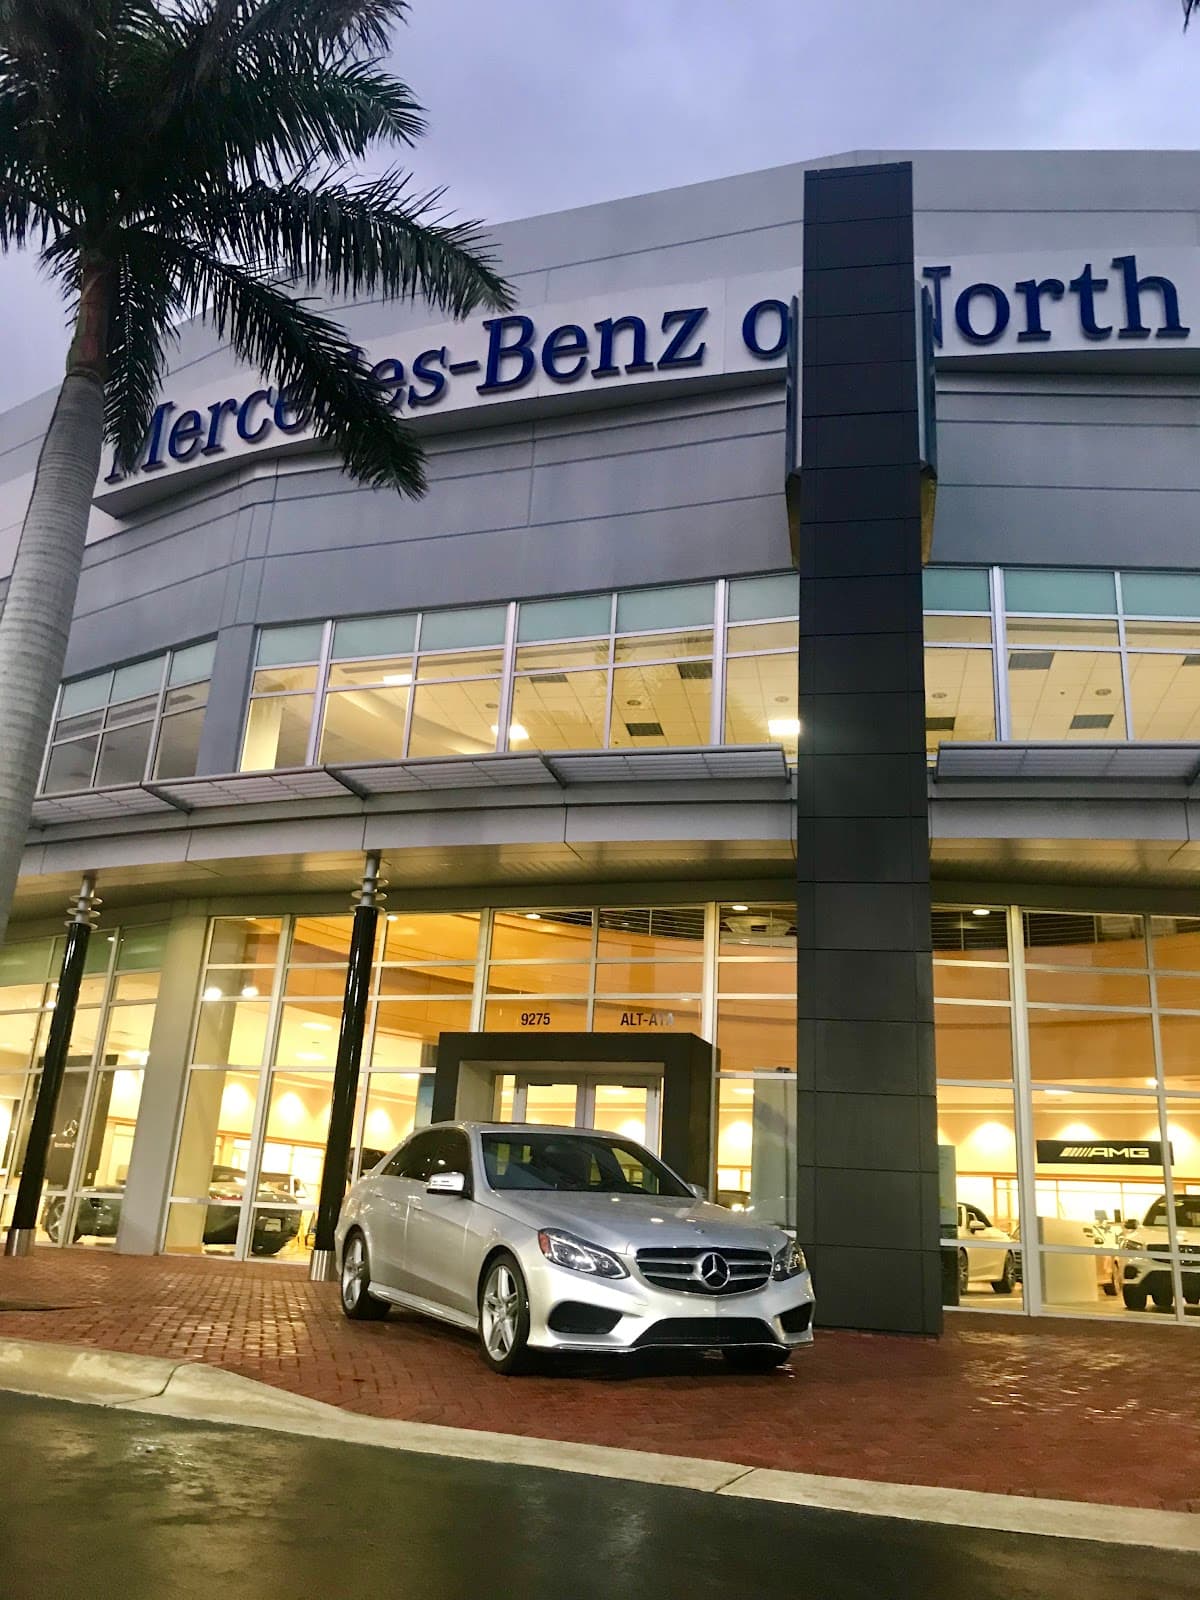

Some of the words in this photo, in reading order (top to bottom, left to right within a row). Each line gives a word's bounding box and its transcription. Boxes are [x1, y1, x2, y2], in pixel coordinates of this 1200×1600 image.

[104, 307, 708, 484] ercees-Benz
[520, 1012, 551, 1026] 9275
[620, 1012, 674, 1026] ALT-A
[1087, 1147, 1150, 1158] AMG
